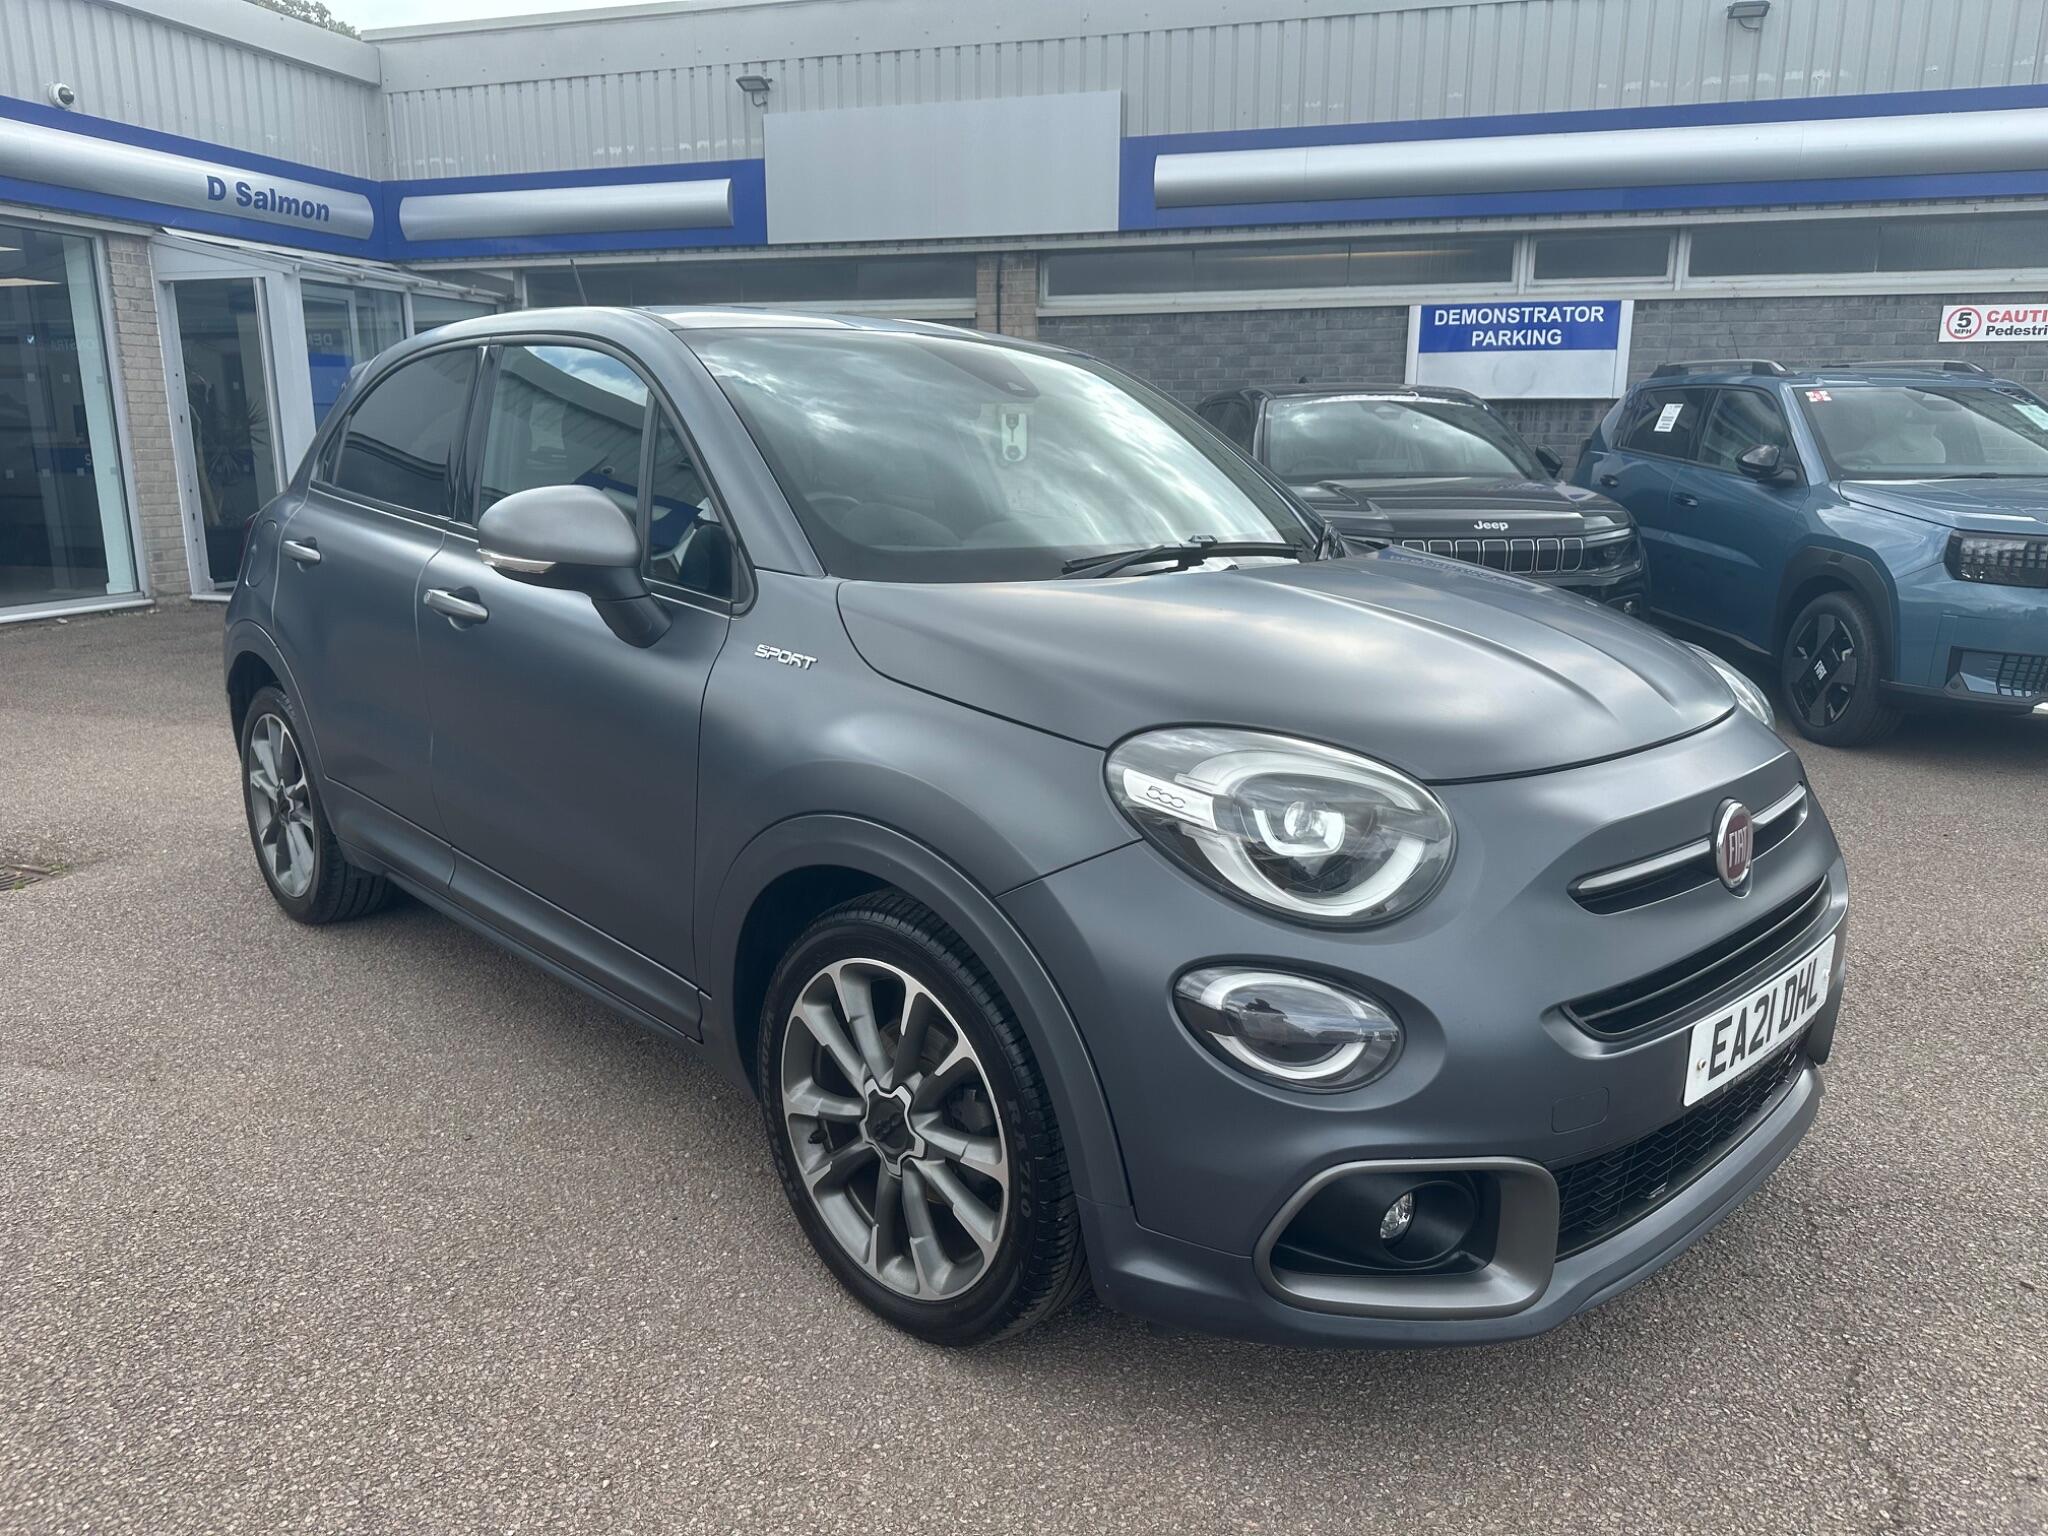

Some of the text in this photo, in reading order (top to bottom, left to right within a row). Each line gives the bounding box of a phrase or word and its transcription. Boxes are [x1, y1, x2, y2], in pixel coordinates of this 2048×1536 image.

[207, 175, 330, 222] D Salmon
[1434, 306, 1604, 326] DEMONSTRATOR
[1957, 312, 1972, 329] 5
[1471, 329, 1562, 347] PARKING
[1985, 325, 2048, 336] Pedestri
[1473, 520, 1509, 531] Jeep
[754, 643, 818, 670] SPORT
[1146, 785, 1186, 809] 500
[1728, 826, 1748, 869] FIAT
[1708, 957, 1817, 1081] EA21 DHL
